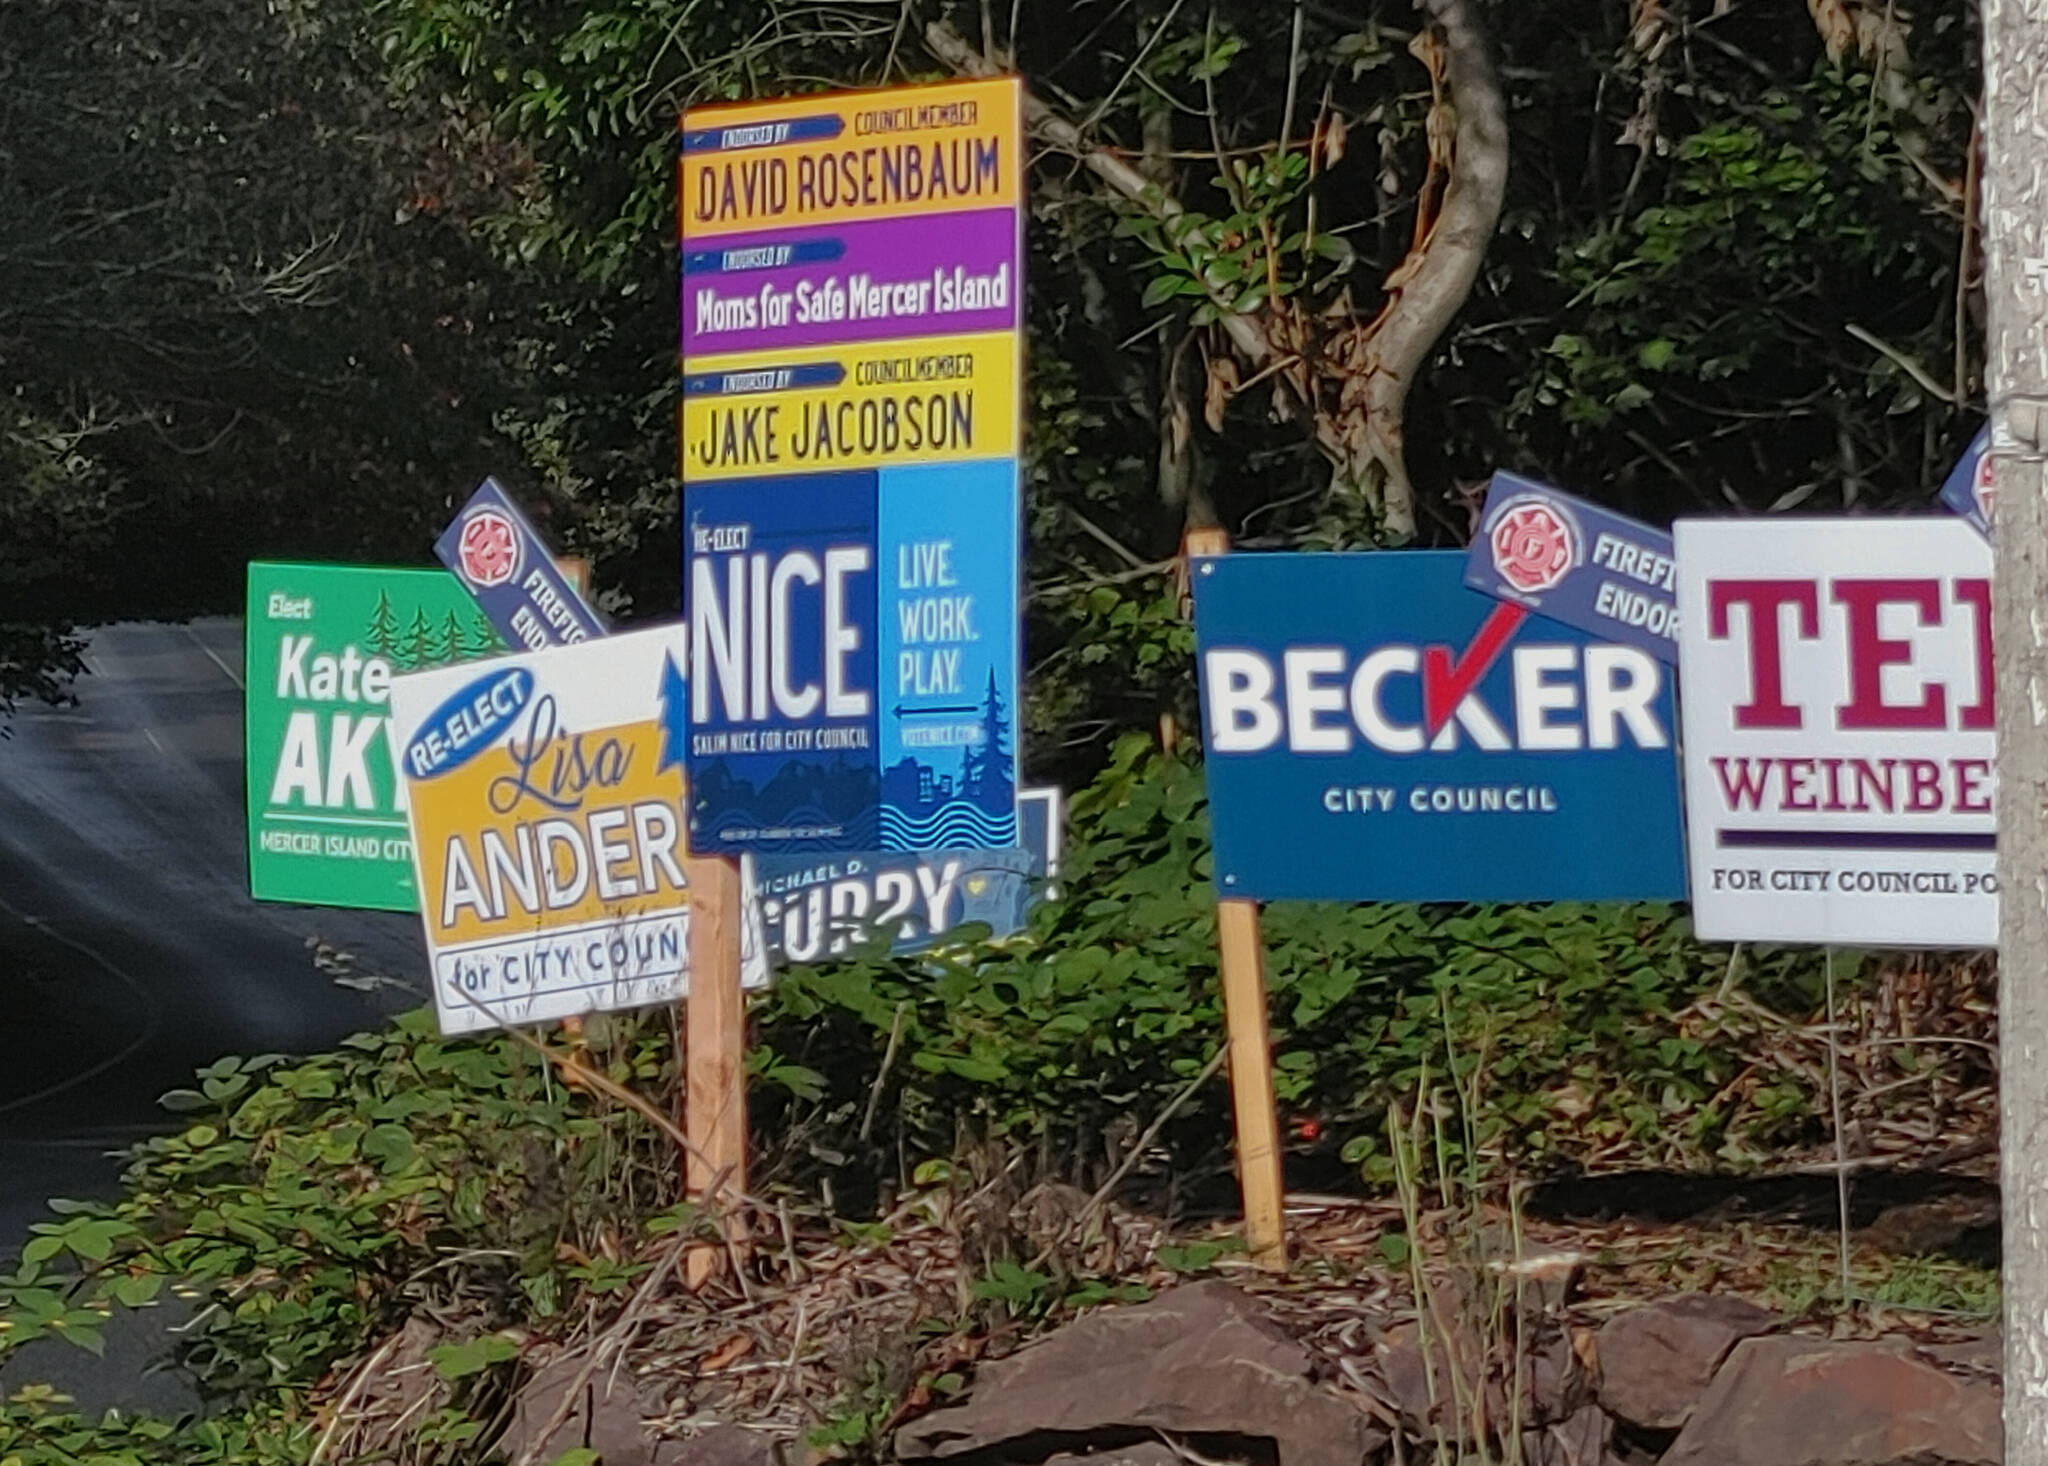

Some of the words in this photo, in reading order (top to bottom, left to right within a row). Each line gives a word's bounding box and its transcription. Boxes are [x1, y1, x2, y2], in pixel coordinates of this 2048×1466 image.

[774, 123, 790, 145] BY
[855, 101, 977, 136] COUNCILMEMBER
[695, 157, 786, 223] DAVID
[797, 136, 1000, 214] ROSENBAUM
[775, 246, 791, 267] BY
[695, 288, 756, 336] Moms
[760, 282, 793, 330] for
[795, 277, 845, 325] Safe
[848, 275, 930, 321] Mercer
[933, 263, 1008, 314] Island
[855, 353, 974, 387] COUNCILMEMBER
[699, 405, 780, 466] JAKE
[791, 389, 974, 461] JACOBSON
[693, 525, 750, 552] RE-ELECT
[267, 592, 313, 620] Elect
[510, 605, 553, 652] END
[898, 597, 980, 645] WORK.
[691, 547, 870, 724] NICE
[277, 632, 391, 703] Kate
[898, 648, 961, 698] PLAY.
[1205, 604, 1666, 754] BECKER
[410, 671, 525, 778] RE-ELECT
[730, 730, 756, 754] NICE
[759, 728, 785, 752] FOR
[786, 727, 813, 751] CITY
[815, 725, 870, 751] COUNCIL
[488, 693, 639, 816] Lisa
[1323, 787, 1396, 814] CITY
[1409, 785, 1559, 814] COUNCIL
[259, 831, 320, 856] MERCER
[324, 833, 381, 858] ISLAND
[440, 797, 687, 928] ANDER
[1712, 868, 1765, 891] FOR
[1771, 870, 1831, 893] CITY
[1838, 871, 1957, 895] COUNCIL
[453, 958, 495, 994] for
[502, 945, 573, 987] CITY
